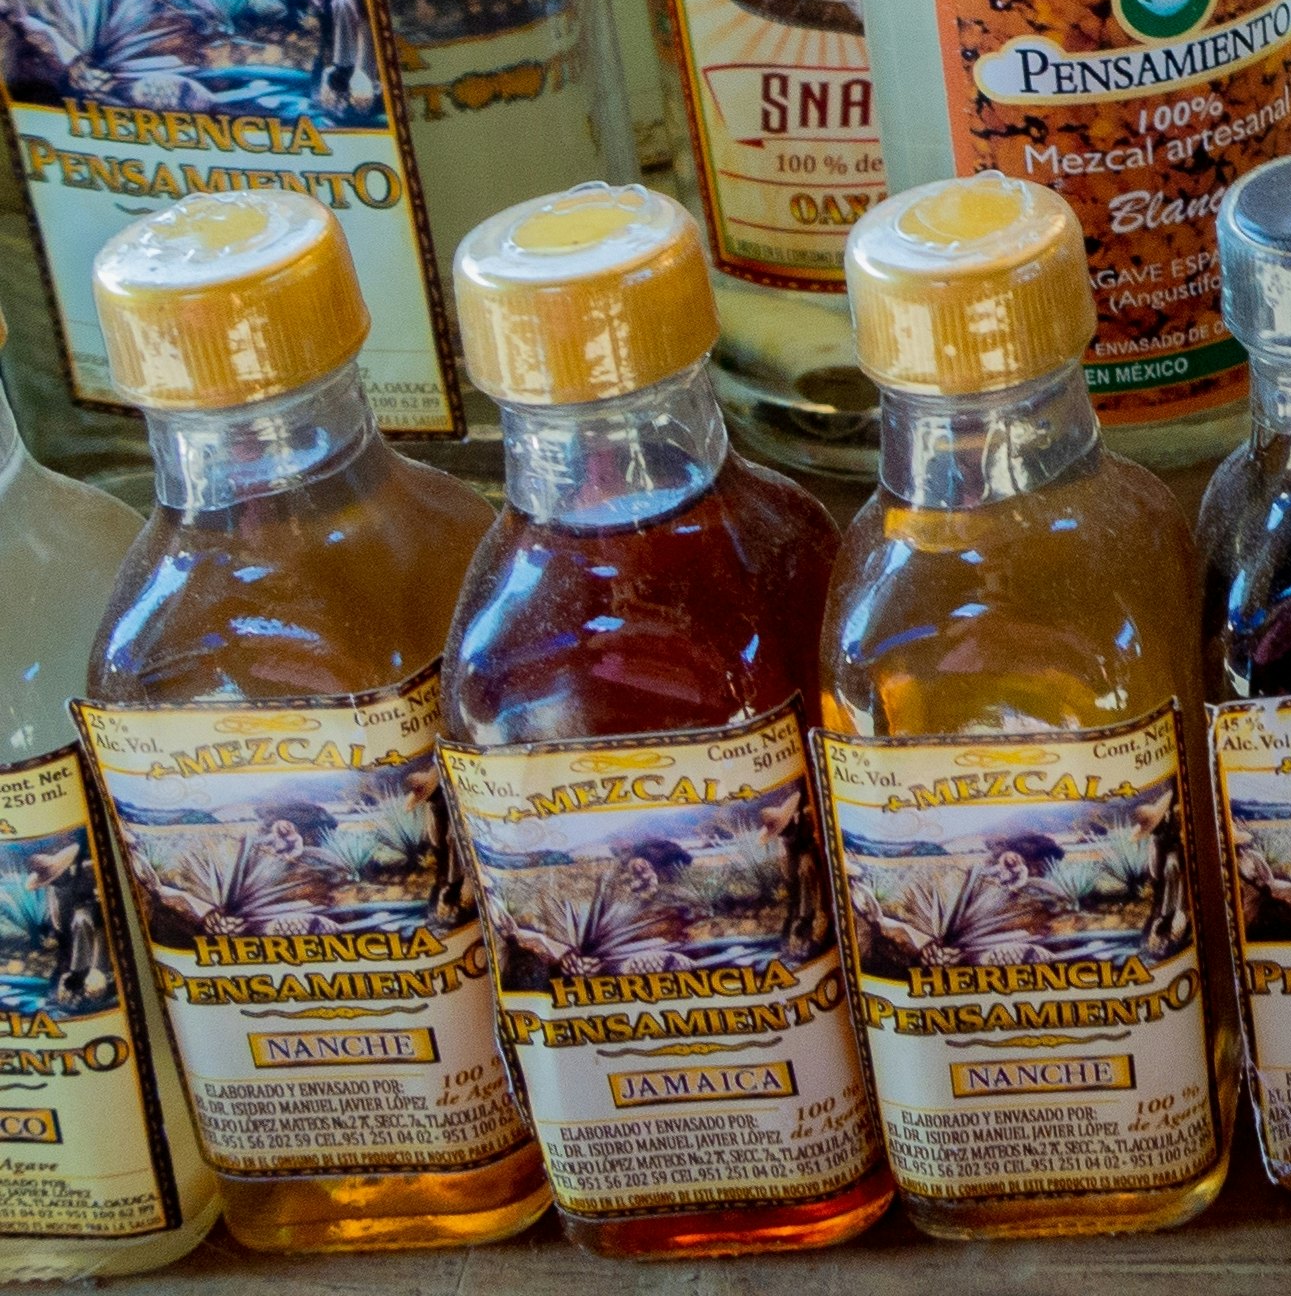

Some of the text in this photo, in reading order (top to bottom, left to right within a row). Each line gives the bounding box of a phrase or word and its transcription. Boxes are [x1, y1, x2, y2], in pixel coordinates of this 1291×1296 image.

[1014, 1, 1291, 95] PENSAMIENTO
[761, 72, 873, 134] SNA
[1138, 90, 1224, 135] 100%
[63, 97, 333, 157] HERENCIA
[1024, 84, 1291, 176] Mezcal artesanal
[20, 132, 402, 211] PENSAMIENTO
[776, 153, 884, 175] 100 % de
[790, 191, 888, 227] OAX
[1095, 325, 1208, 357] ENVASADO DE
[1084, 356, 1190, 386] EN MÉXICO
[353, 705, 406, 729] Cont.
[400, 718, 420, 738] 50
[95, 733, 164, 756] Alc. Vol.
[172, 736, 371, 778] MEZCAL
[707, 721, 797, 763] Cont. Net.
[1093, 739, 1141, 761] Cont.
[1223, 736, 1257, 752] Alc.
[753, 754, 772, 773] 50
[833, 768, 901, 788] Alc. Vol.
[0, 777, 34, 793] ont.
[2, 784, 67, 809] 250 ml.
[457, 775, 519, 798] Alc. Vol.
[529, 775, 725, 817] MEZCAL
[909, 770, 1103, 811] MEZCAL
[193, 927, 448, 967] HERENCIA
[152, 939, 489, 1005] PENSAMIENTO
[549, 959, 799, 1009] HERENCIA
[907, 955, 1154, 998] HERENCIA
[505, 966, 846, 1047] PENSAMIENTO
[863, 968, 1200, 1036] PENSAMIENTO
[266, 1034, 415, 1061] NANCHE
[620, 1068, 784, 1100] JAMAICA
[968, 1062, 1112, 1091] NANCHE
[902, 1110, 981, 1129] ELABORADO
[995, 1108, 1066, 1125] ENVASADO
[1068, 1106, 1098, 1124] POR:
[973, 1124, 1075, 1143] MANUEL JAVIER
